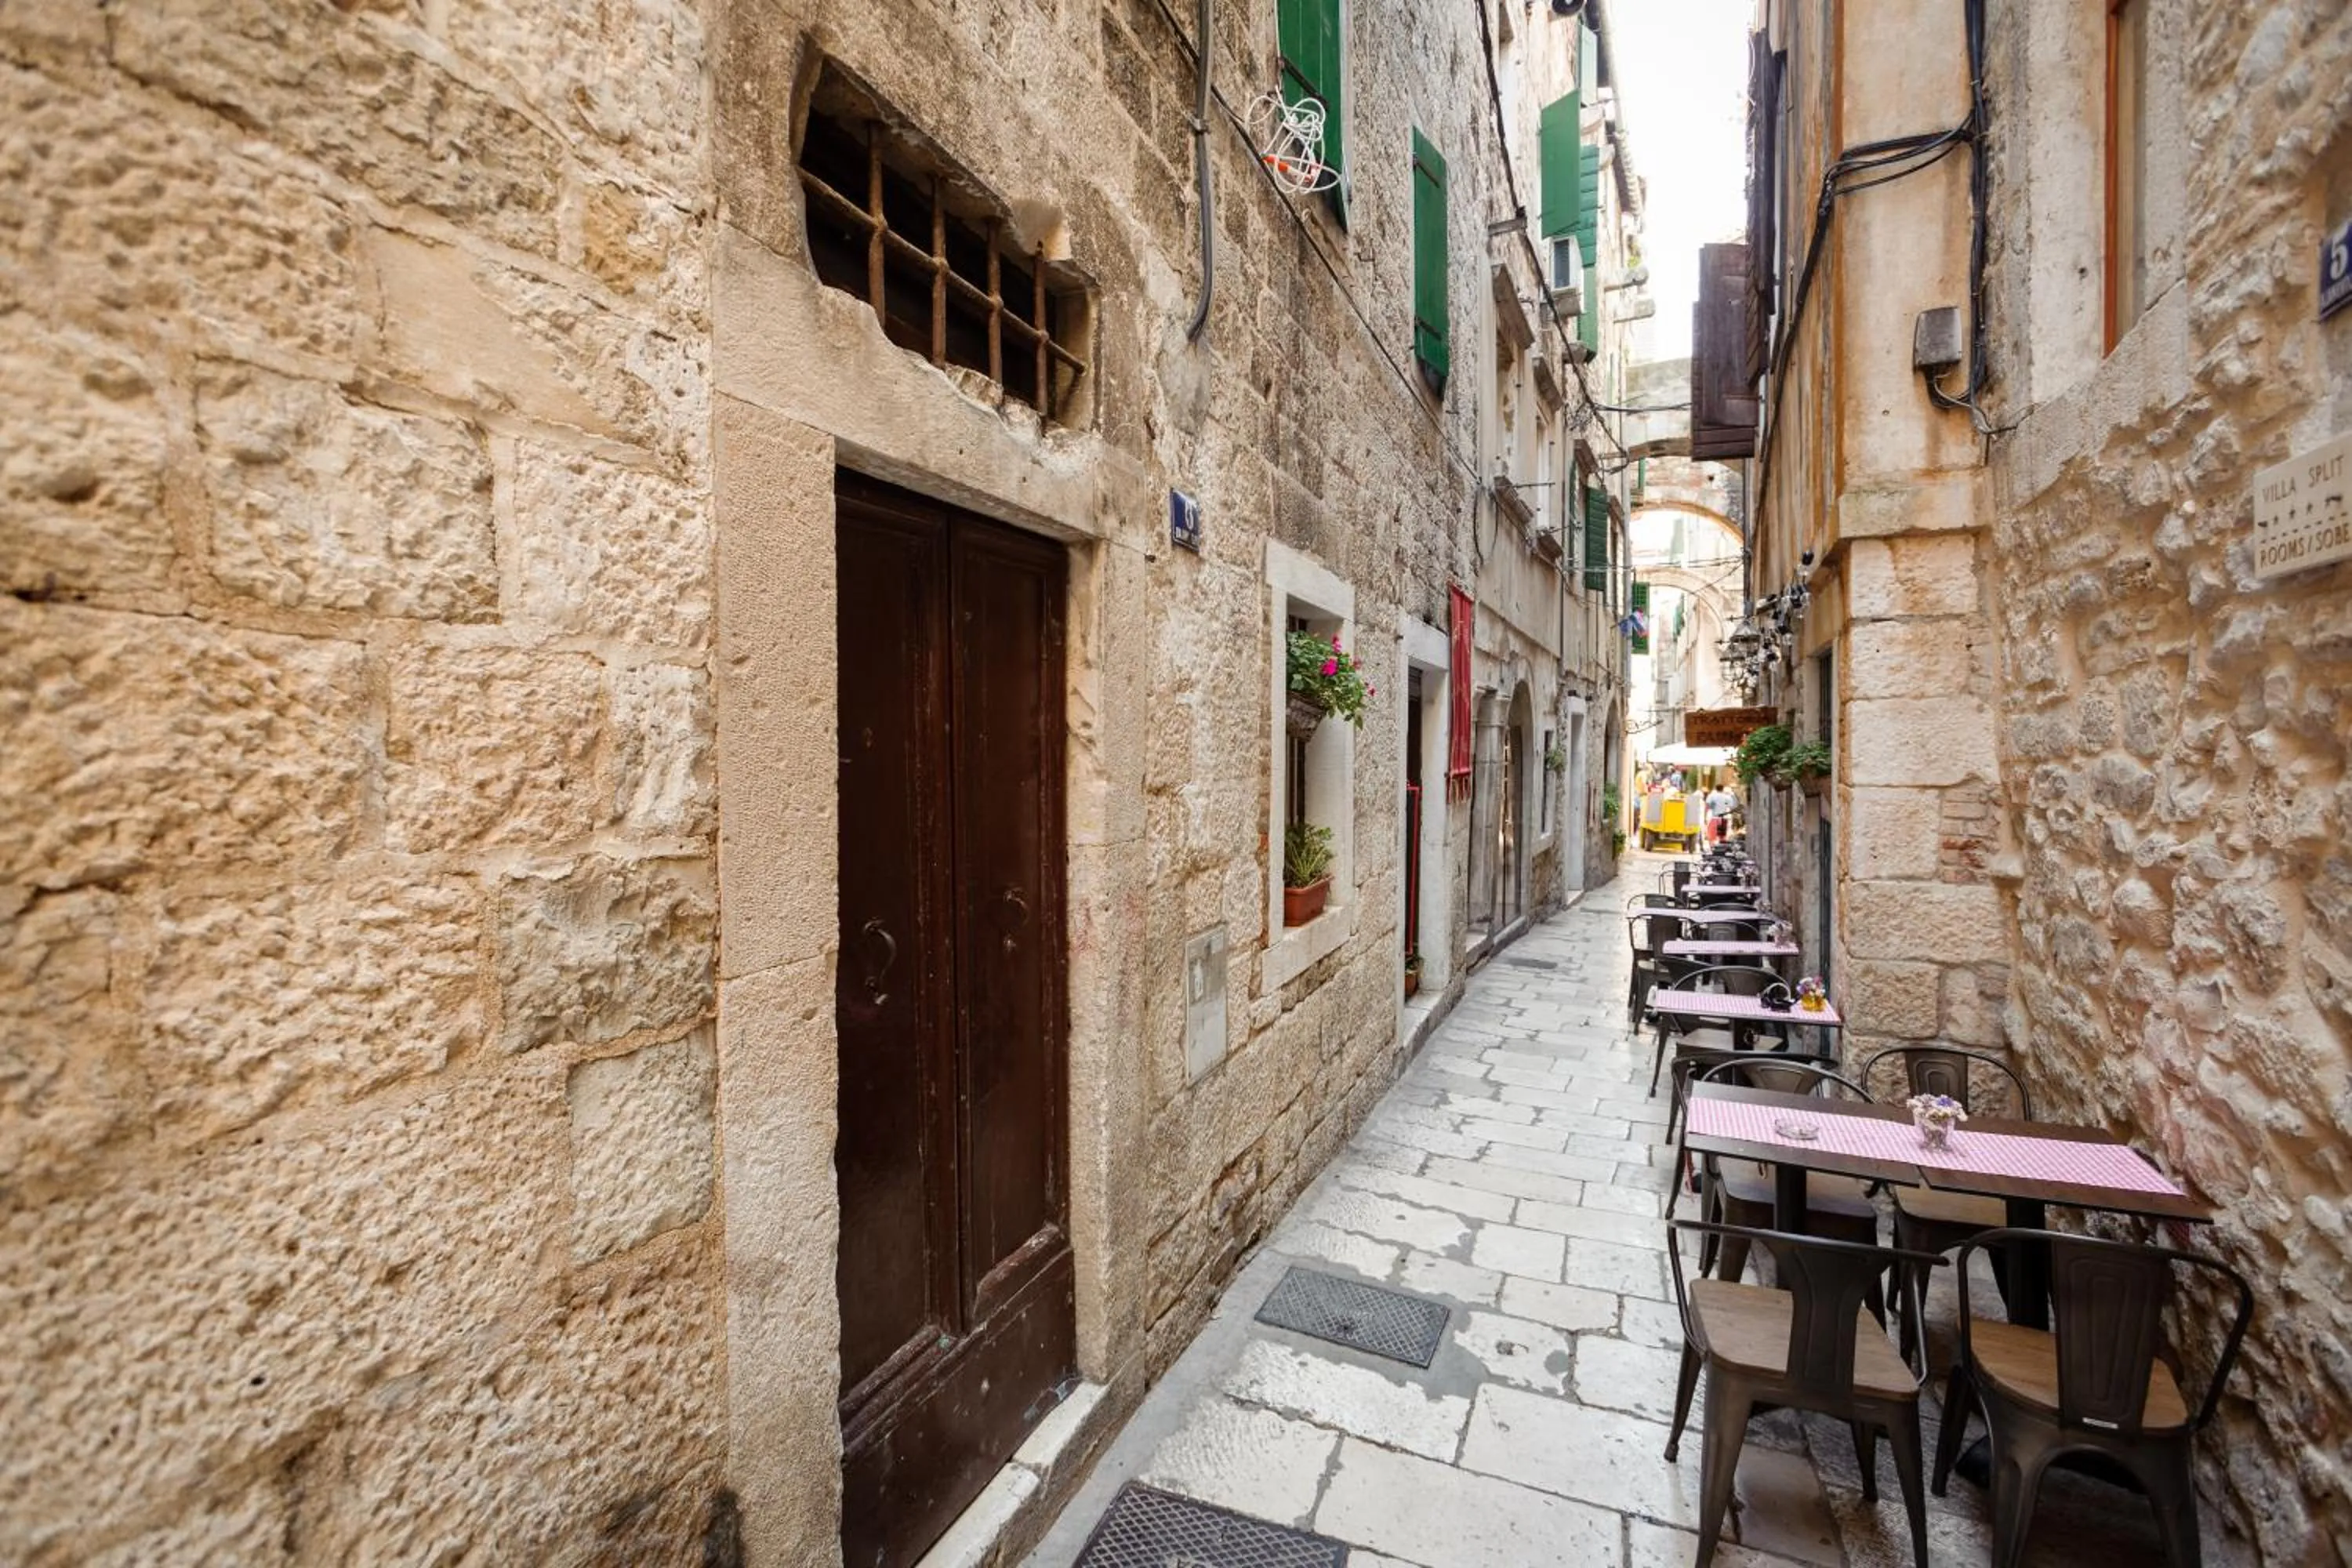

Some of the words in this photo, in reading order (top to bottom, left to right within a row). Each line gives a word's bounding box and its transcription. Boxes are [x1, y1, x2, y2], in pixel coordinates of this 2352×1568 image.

[2330, 220, 2350, 280] 5
[2263, 477, 2296, 503] VILLA
[2308, 454, 2344, 488] SPLIT
